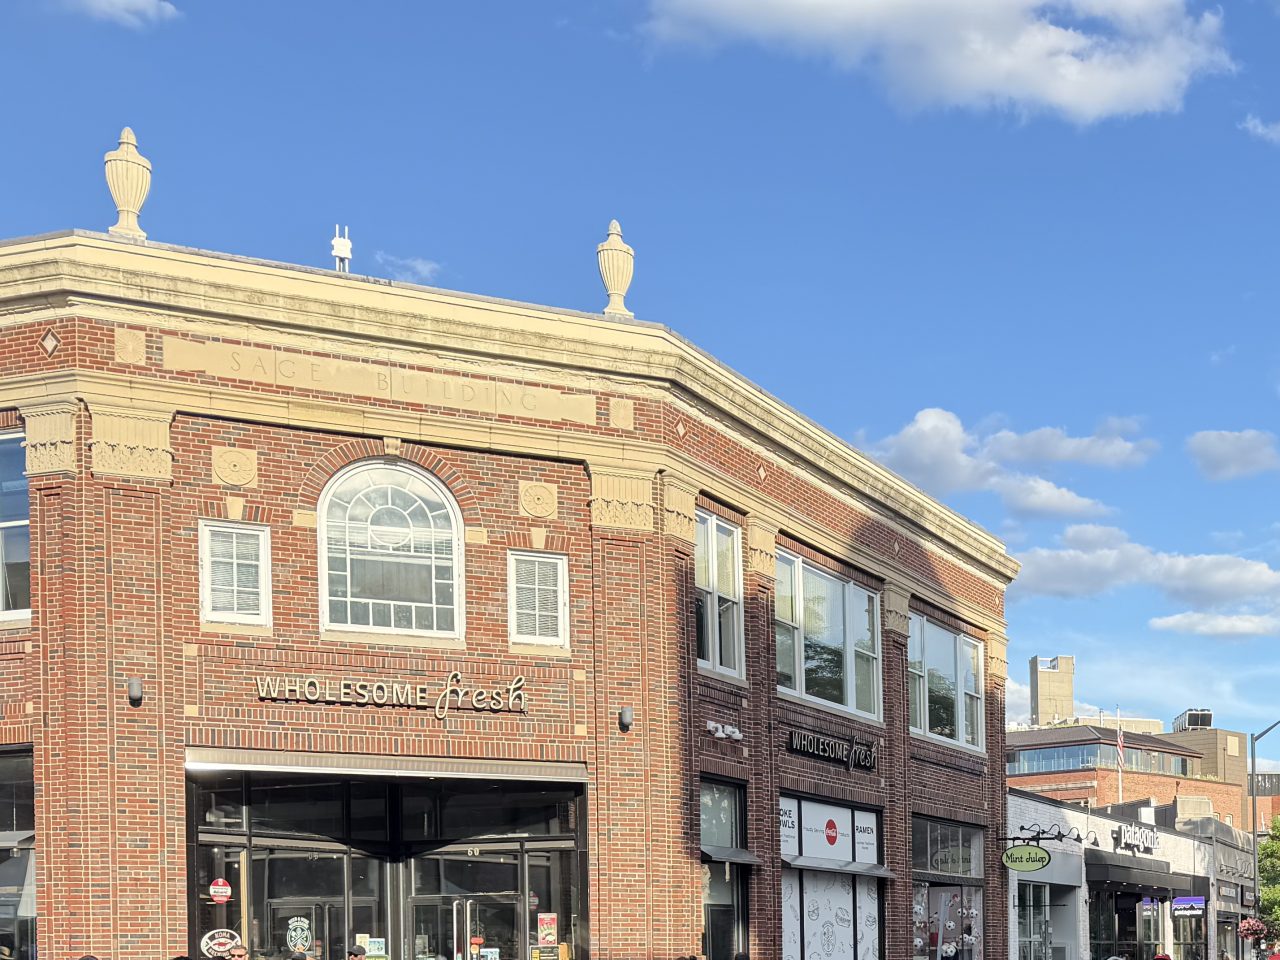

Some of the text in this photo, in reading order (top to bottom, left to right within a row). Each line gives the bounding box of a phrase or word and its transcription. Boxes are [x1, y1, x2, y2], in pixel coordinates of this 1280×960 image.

[255, 671, 526, 719] WHOLESOME fresh
[792, 731, 877, 771] WHOLESOME fresh
[780, 808, 793, 819] OKE
[780, 819, 796, 829] WLS
[856, 825, 874, 836] RAMEN
[1121, 822, 1160, 851] patagonia
[1005, 851, 1047, 867] Mint Julep
